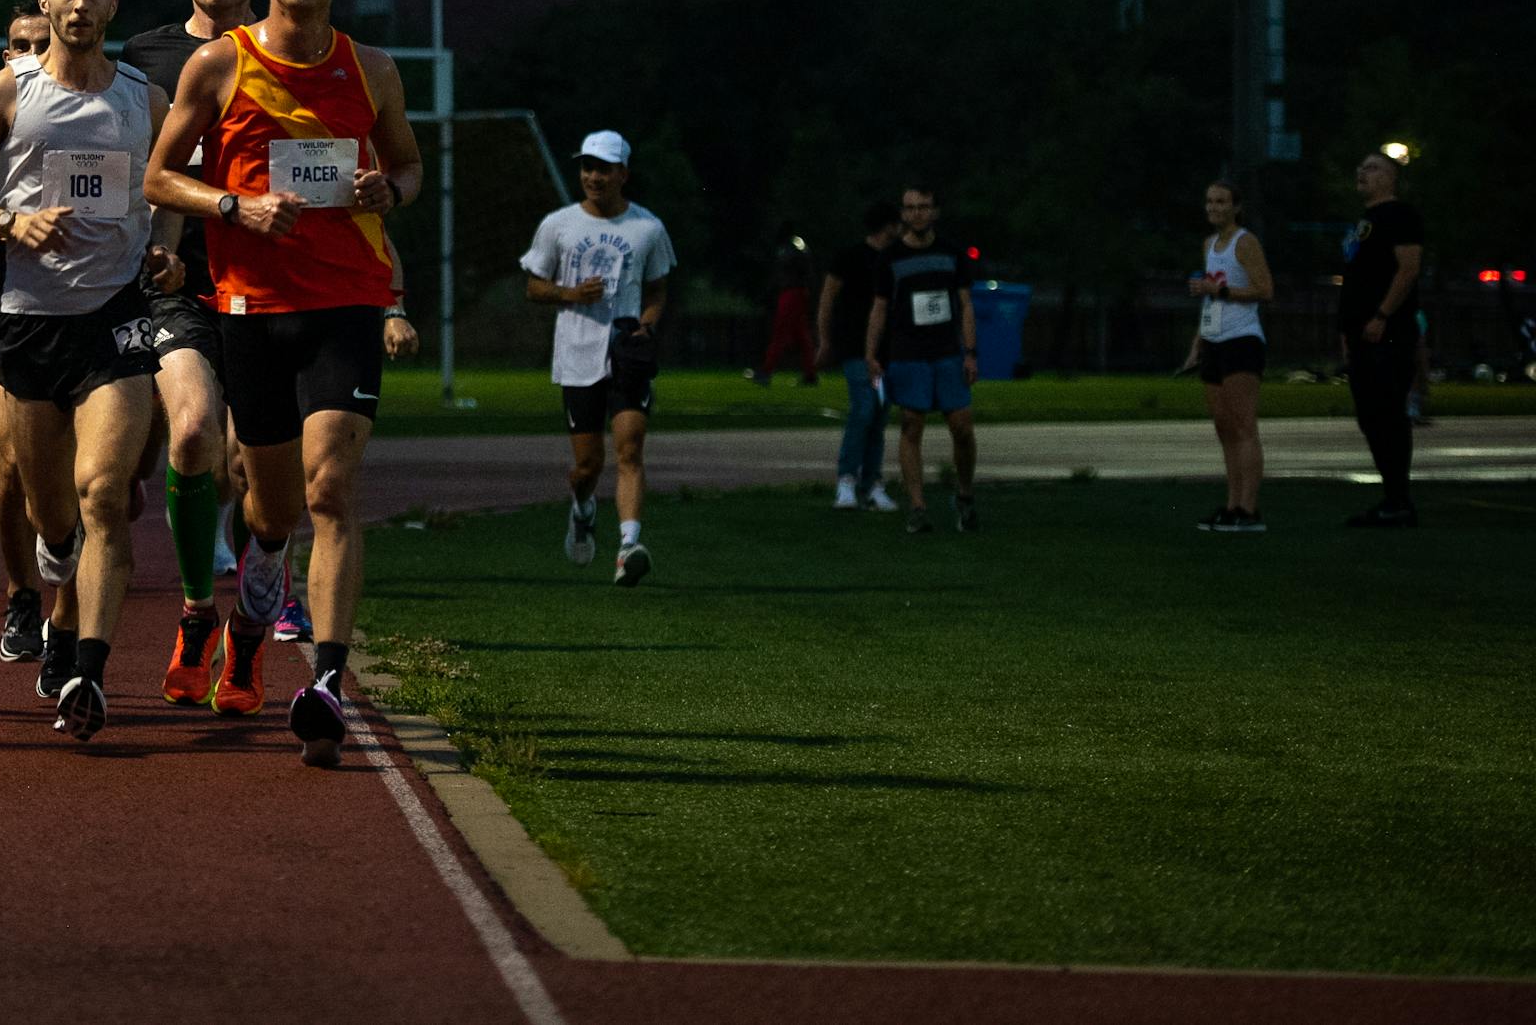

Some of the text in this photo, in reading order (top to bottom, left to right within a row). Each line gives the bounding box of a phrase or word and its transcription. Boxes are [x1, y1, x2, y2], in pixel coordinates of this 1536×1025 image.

[70, 174, 102, 198] 108
[292, 165, 338, 183] PACER
[114, 318, 155, 355] 28
